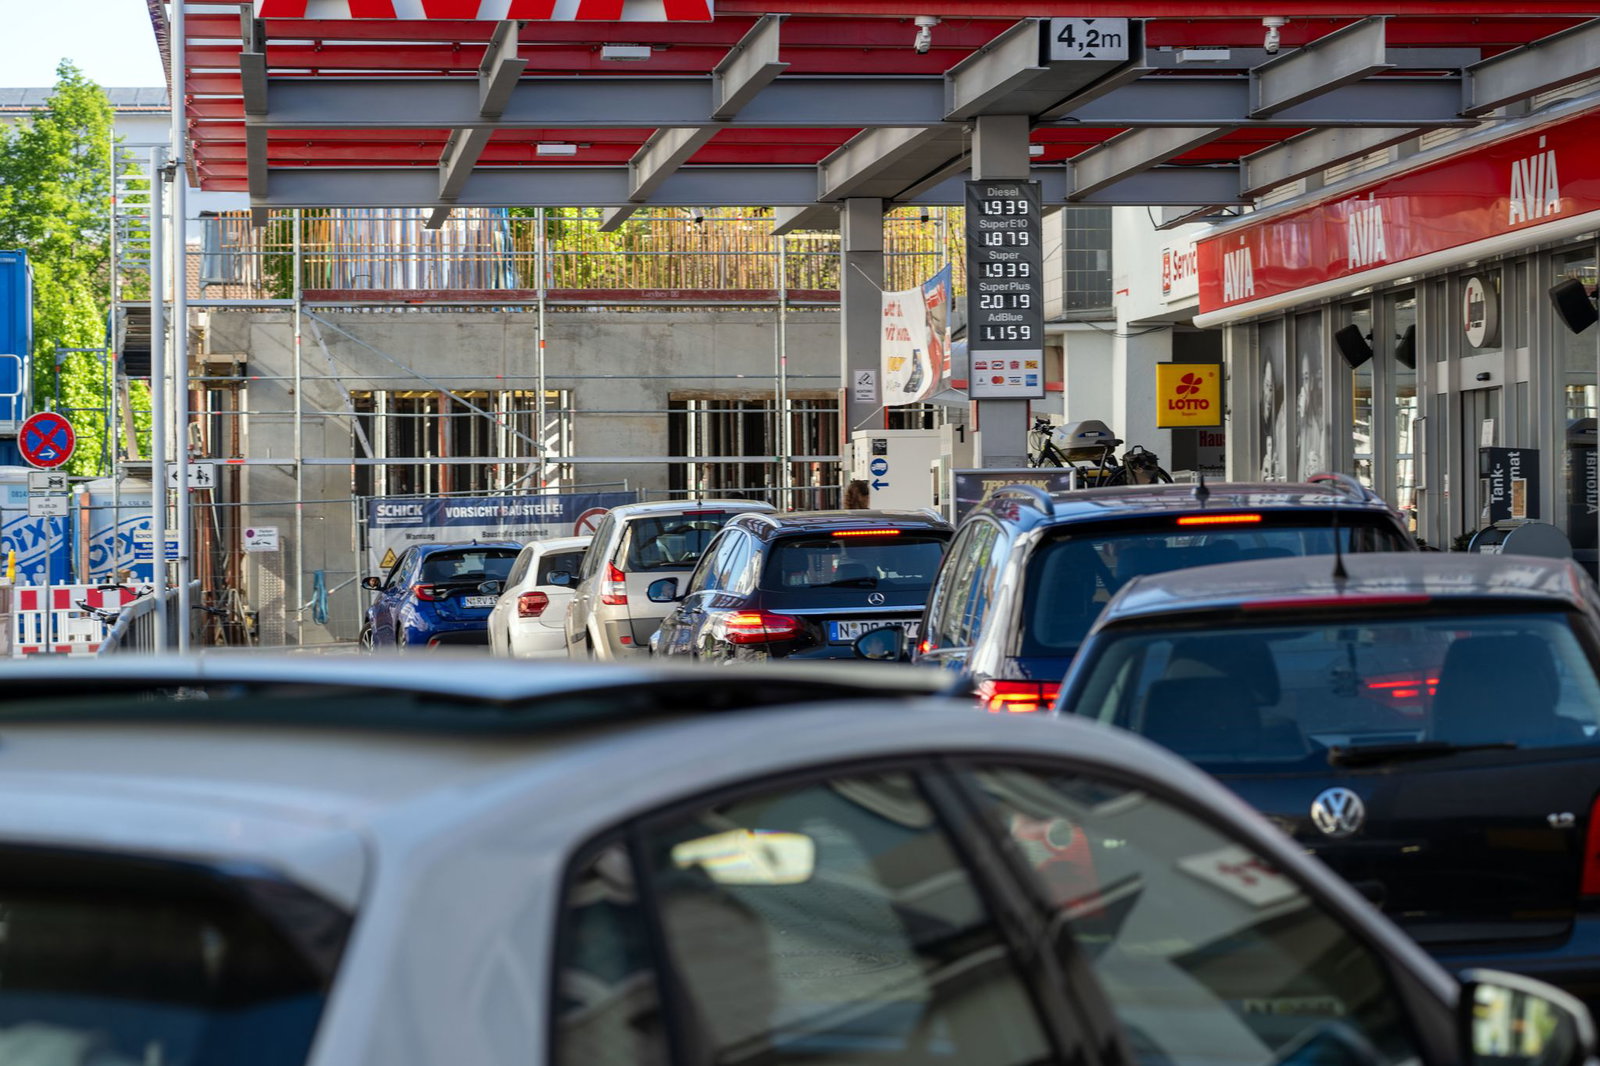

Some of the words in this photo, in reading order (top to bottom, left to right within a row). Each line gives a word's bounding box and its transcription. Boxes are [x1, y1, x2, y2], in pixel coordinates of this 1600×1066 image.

[1057, 23, 1121, 52] 4,2m
[1508, 134, 1561, 226] AVIA
[987, 187, 1019, 197] Diesel
[984, 200, 1028, 215] 1.939
[979, 219, 1009, 229] Super
[1009, 219, 1028, 228] E10
[1347, 191, 1387, 270] AVIA
[985, 231, 1029, 246] 1.879
[989, 251, 1020, 260] Super
[985, 263, 1029, 278] 1.939
[1223, 235, 1255, 303] AVIA
[979, 282, 1009, 292] Super
[1009, 282, 1031, 291] Plus
[980, 294, 1030, 309] 2.019
[988, 312, 1023, 322] AdBlue
[986, 325, 1031, 340] 1.159
[1168, 398, 1210, 410] LOTTO
[955, 424, 964, 443] 1
[1491, 463, 1504, 504] Tank-
[376, 504, 424, 517] SCHICK
[445, 506, 499, 518] VORSICHT
[500, 503, 564, 517] BAUSTELLE!
[405, 532, 435, 541] Warnung
[839, 623, 849, 638] N
